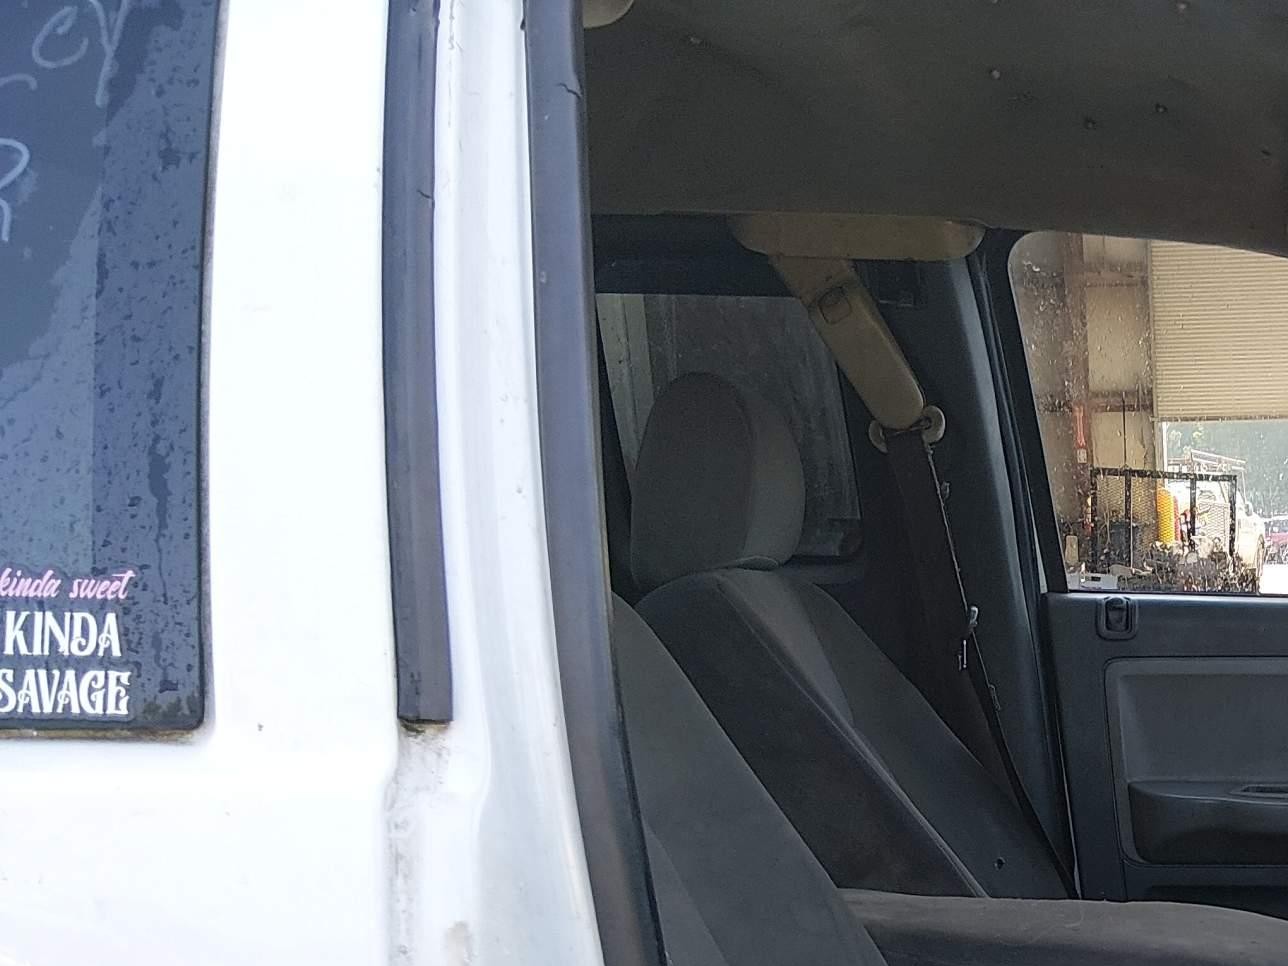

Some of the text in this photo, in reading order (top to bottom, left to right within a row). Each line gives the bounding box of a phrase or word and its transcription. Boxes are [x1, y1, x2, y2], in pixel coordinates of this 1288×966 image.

[0, 567, 136, 600] kinda sweet
[3, 610, 122, 657] KINDA
[0, 667, 131, 715] SAVAGE
